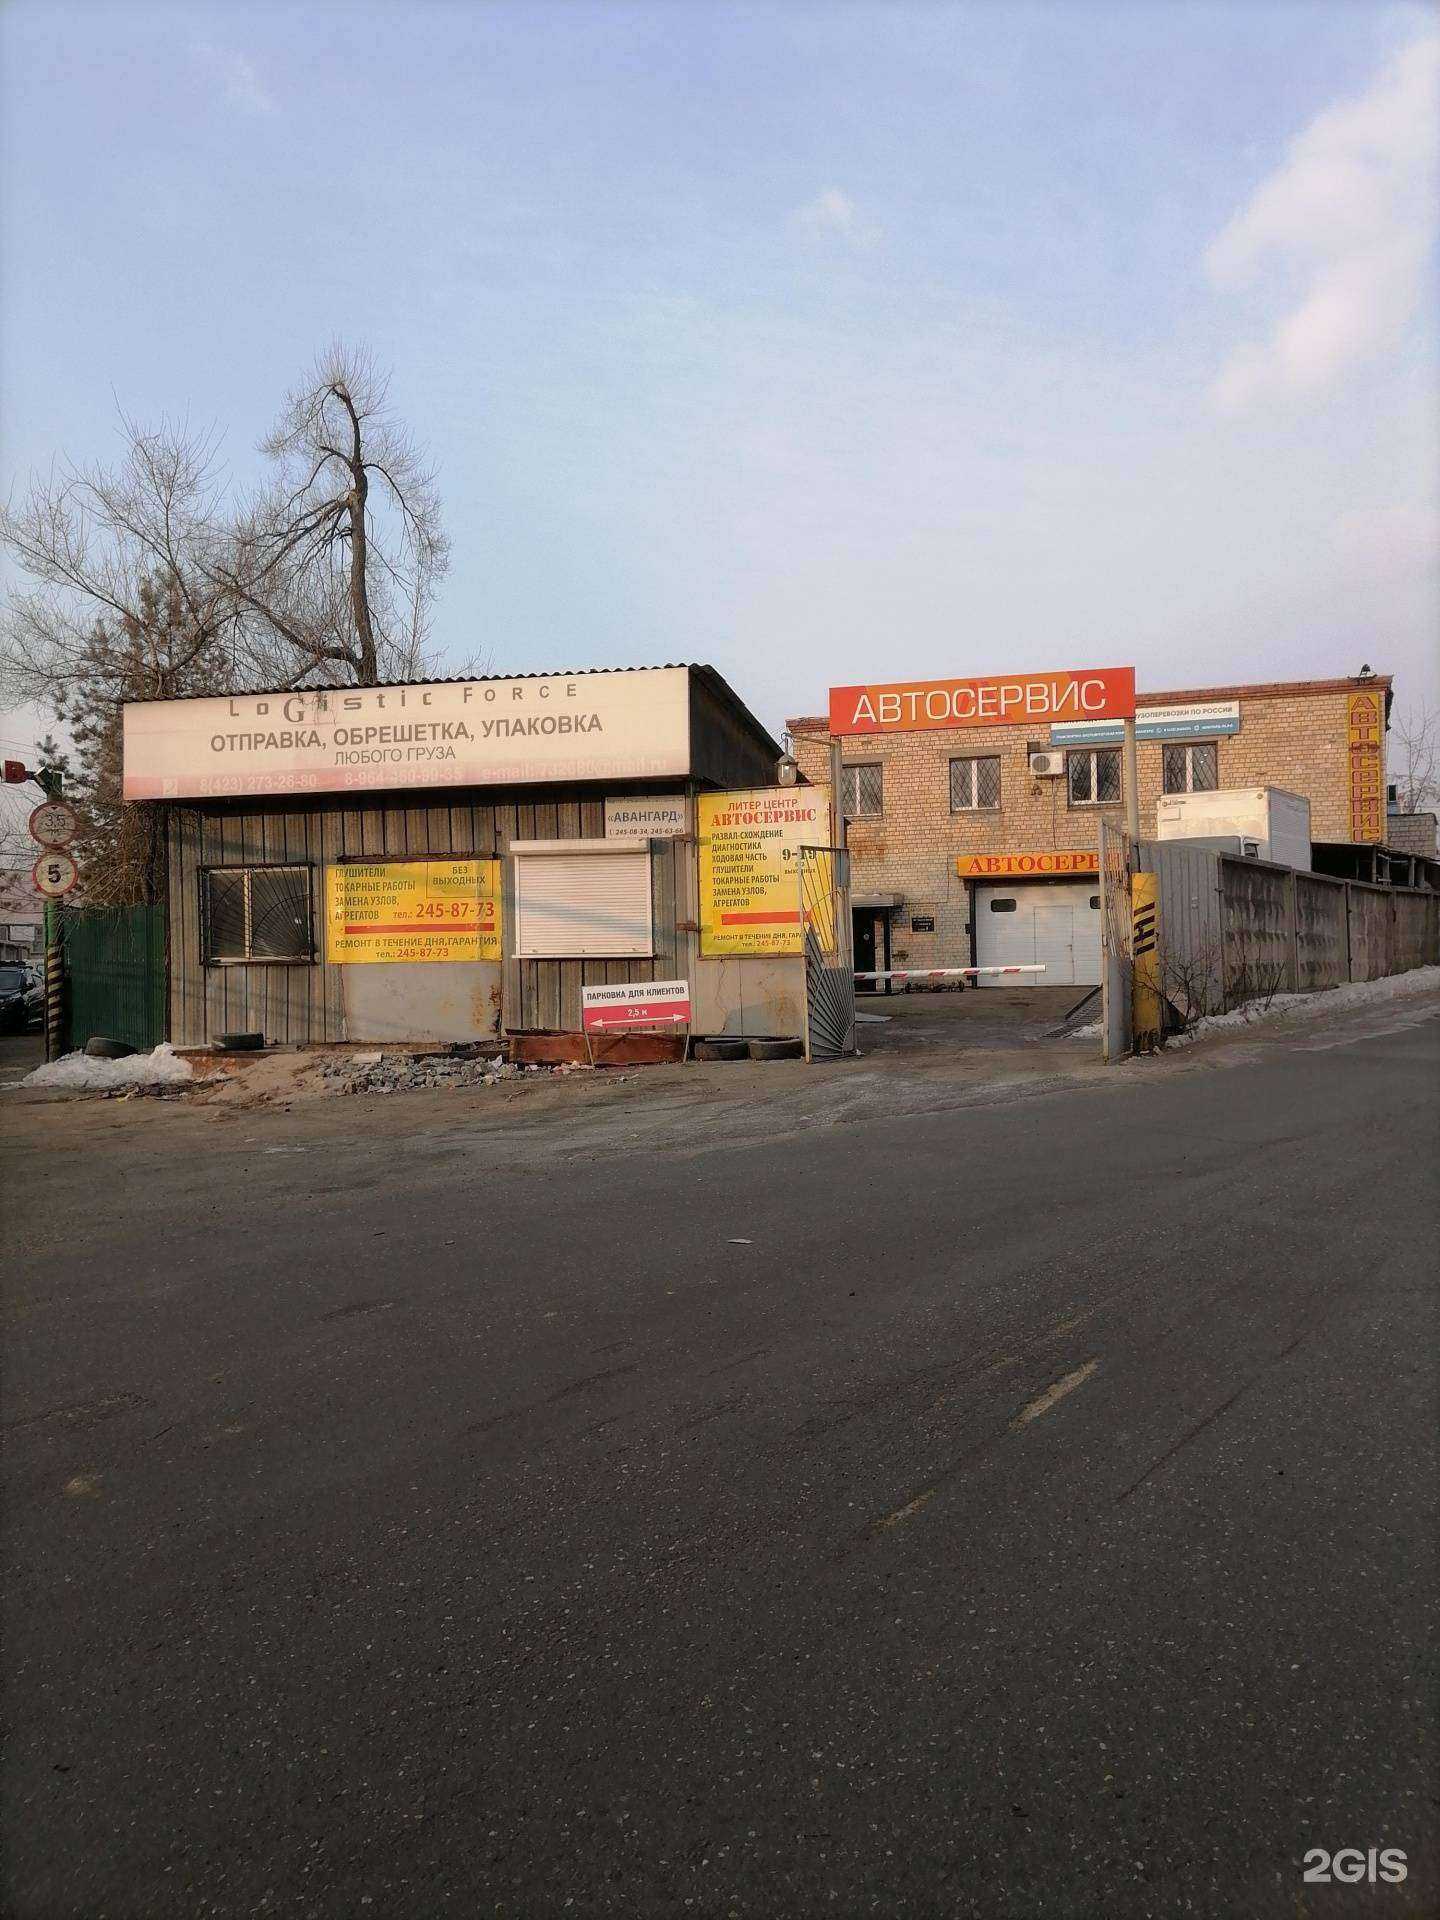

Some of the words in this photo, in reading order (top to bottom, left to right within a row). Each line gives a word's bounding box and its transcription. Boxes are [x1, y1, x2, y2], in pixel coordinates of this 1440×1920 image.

[851, 679, 1106, 724] АВТОСЕРВИС
[1136, 710, 1190, 719] УЗОПЕРЕВОЗКИ
[1190, 708, 1202, 716] ПО
[1202, 706, 1233, 714] РОССИИ
[210, 730, 327, 752] ОТПРАВКА,
[333, 721, 475, 745] ОБРЕШЕТКА,
[482, 714, 603, 738] УПАКОВКА
[334, 748, 402, 765] ЛЮБОГО
[407, 746, 456, 761] ГРУЗА
[1350, 696, 1380, 842] АВТОСЕРВИС
[728, 802, 761, 811] ЛИТЕР
[763, 799, 798, 809] ЦЕНТР
[608, 811, 684, 823] «АВАНГАРД»
[711, 809, 817, 826] АВТОСЕРВИС
[712, 829, 784, 840] РАЗВАЛ-СХОЖДЕНИЕ
[712, 842, 762, 853] ДИАГНОСТИКА
[712, 854, 743, 863] ХОДОВАЯ
[745, 853, 767, 861] ЧАСТЬ
[48, 864, 62, 883] 5
[335, 868, 386, 878] ГЛУШИТЕЛИ
[452, 866, 468, 874] БЕЗ
[712, 865, 754, 874] ГЛУШИТЕЛИ
[433, 875, 486, 885] ВЫХОДНЫХ
[712, 876, 750, 885] ТОКАРНЫЕ
[751, 875, 780, 884] РАБОТЫ
[335, 881, 380, 892] ТОКАРНЫЕ
[382, 880, 416, 891] РАБОТЫ
[712, 888, 740, 897] ЗАМЕНА
[742, 886, 767, 896] УЗЛОВ,
[335, 896, 368, 907] ЗАМЕНА
[371, 895, 400, 906] УЗЛОВ,
[713, 899, 750, 908] АГРЕГАТОВ
[335, 910, 379, 920] АГРЕГАТОВ
[416, 902, 495, 918] 245-87-73
[335, 938, 371, 948] РЕМОНТ
[375, 938, 381, 947] В
[383, 937, 423, 947] ТЕЧЕНИЕ
[397, 948, 449, 958] 245-87-73
[587, 990, 626, 1000] ПАРКОВКА
[628, 989, 644, 998] ДЛЯ
[646, 986, 685, 997] КЛИЕНТОВ
